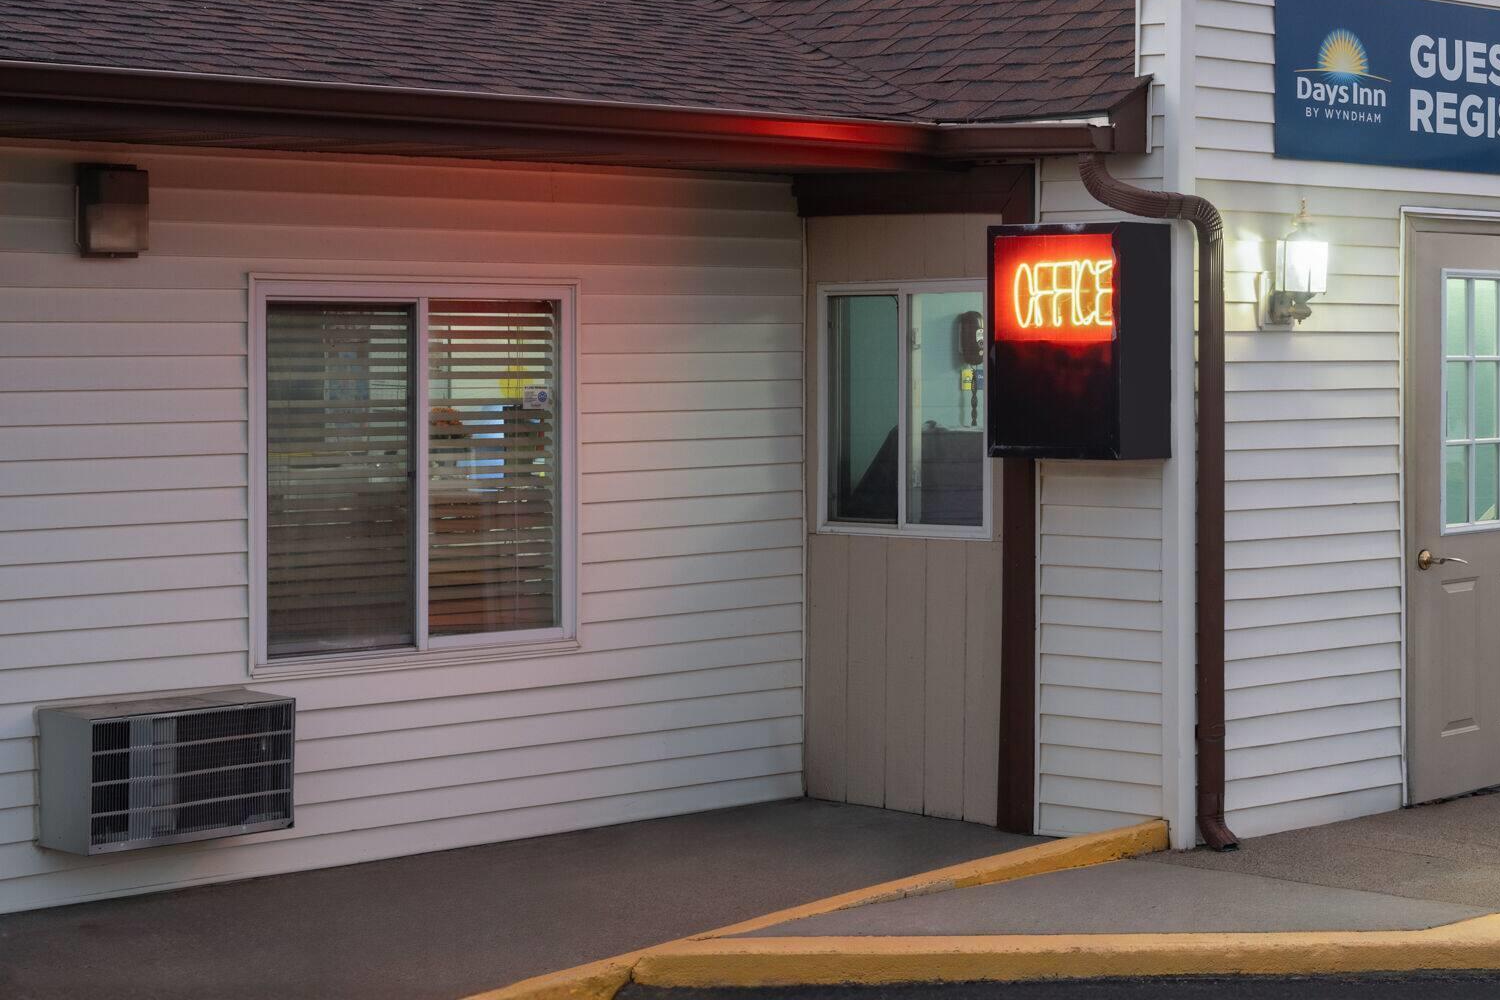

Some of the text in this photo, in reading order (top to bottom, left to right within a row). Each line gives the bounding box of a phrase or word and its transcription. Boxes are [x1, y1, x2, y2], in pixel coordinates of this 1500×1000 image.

[1297, 76, 1386, 107] Days Inn
[1305, 107, 1381, 123] BY WYNDHAM
[1013, 259, 1112, 328] OFFICE
